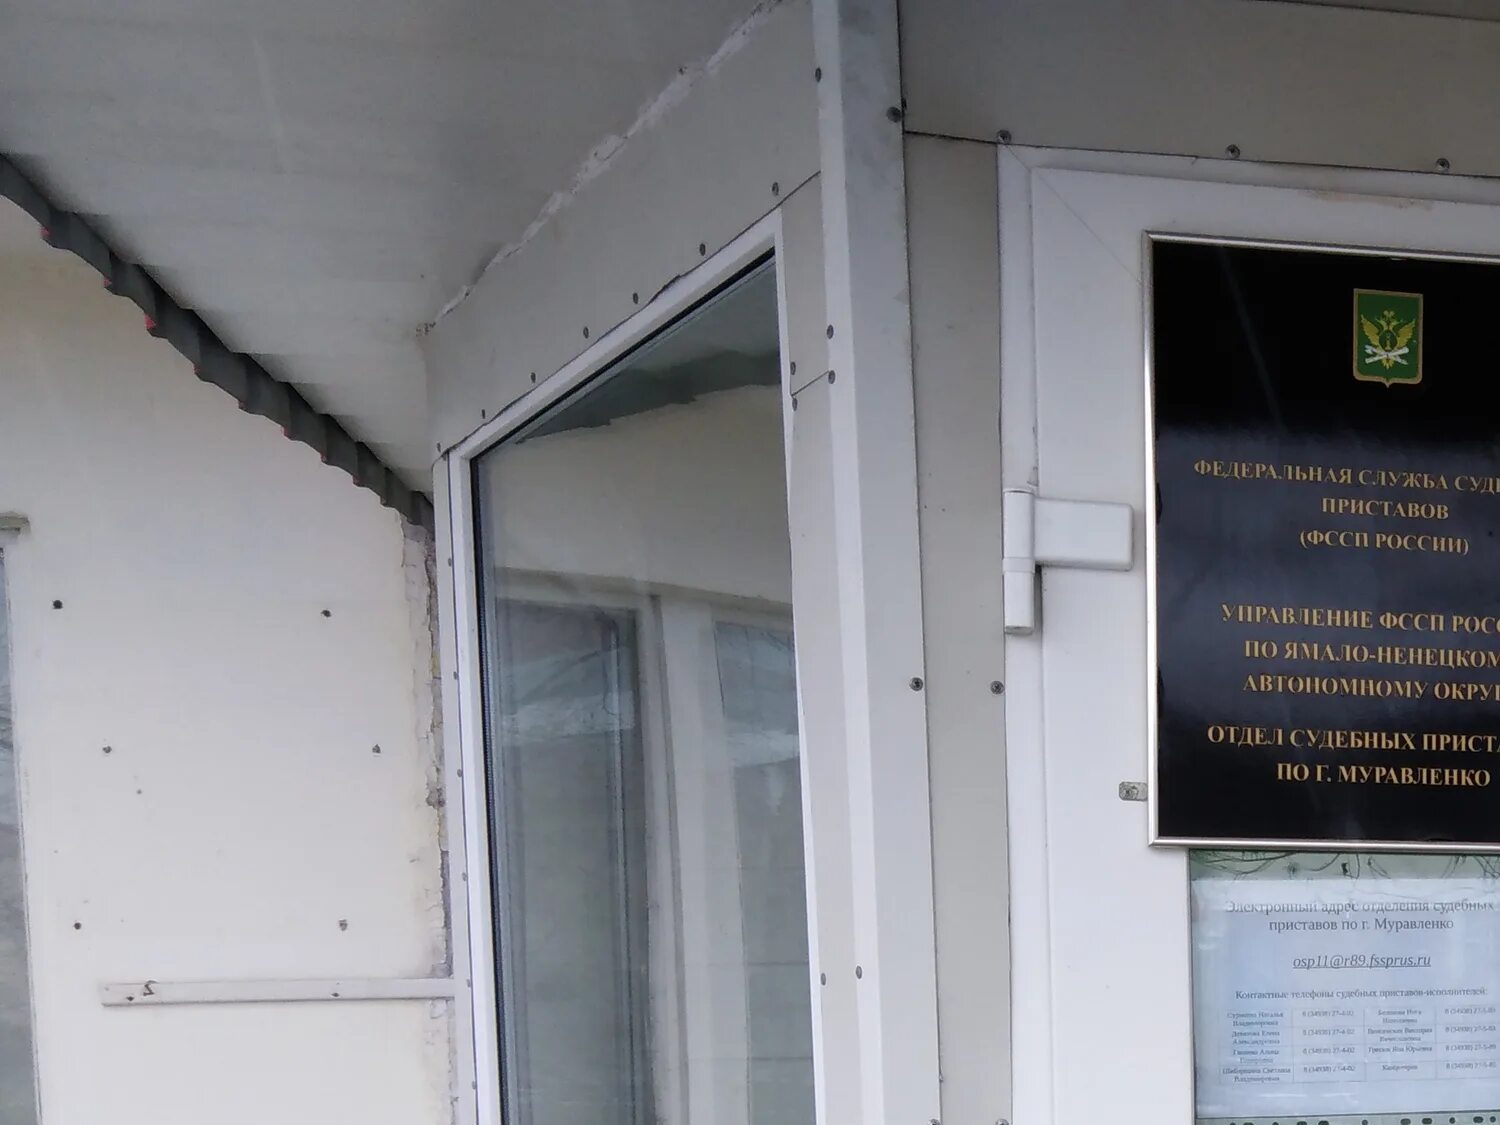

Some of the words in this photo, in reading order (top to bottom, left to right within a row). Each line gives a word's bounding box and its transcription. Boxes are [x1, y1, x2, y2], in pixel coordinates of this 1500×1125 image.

[1193, 458, 1352, 485] ФЕДЕРАЛЬНАЯ
[1358, 468, 1449, 490] СЛУЖБА
[1321, 497, 1449, 520] ПРИСТАВОВ
[1300, 529, 1369, 549] (ФССП
[1375, 532, 1470, 555] РОССИИ)
[1222, 603, 1373, 629] УПРАВЛЕНИЕ
[1379, 611, 1445, 632] ФССП
[1244, 640, 1278, 658] ПО
[1243, 674, 1428, 700] АВТОНОМНОМУ
[1207, 725, 1283, 747] ОТДЕЛ
[1289, 728, 1416, 750] СУДЕБНЫХ
[1276, 763, 1309, 782] ПО
[1315, 764, 1332, 782] Г.
[1338, 765, 1491, 787] МУРАВЛЕНКО
[1226, 900, 1318, 915] Электронный
[1321, 901, 1358, 915] адрес
[1362, 900, 1430, 914] отделения
[1432, 898, 1494, 915] судебных
[1269, 919, 1338, 933] приставов
[1341, 919, 1358, 930] по
[1374, 917, 1454, 933] Муравленко
[1292, 953, 1431, 970] osp11@r89.fssprus.ru
[1235, 989, 1289, 1000] Контактные
[1291, 989, 1334, 1000] телефоны
[1336, 988, 1378, 999] судебных
